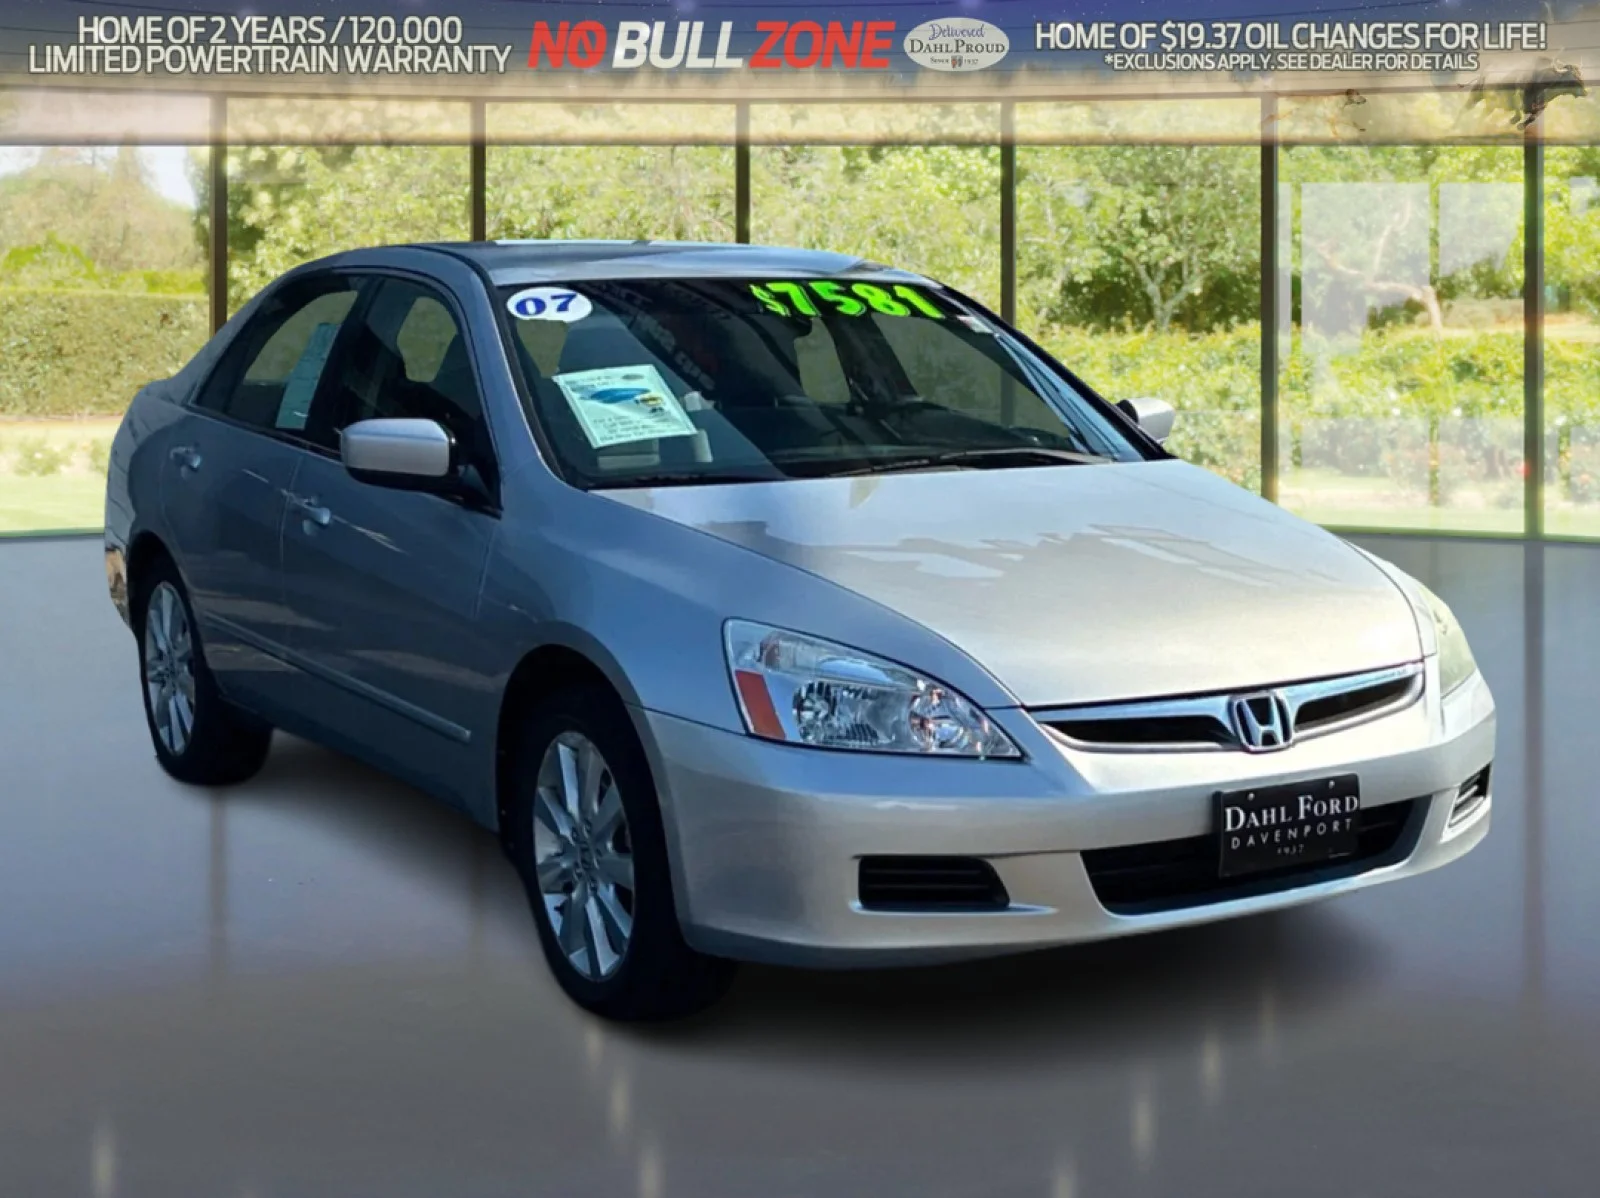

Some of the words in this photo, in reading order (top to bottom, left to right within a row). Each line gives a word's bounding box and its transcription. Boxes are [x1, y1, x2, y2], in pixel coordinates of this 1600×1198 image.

[515, 292, 577, 316] 07
[750, 281, 946, 319] $7581
[1224, 805, 1292, 832] DAHL
[1297, 795, 1358, 820] FORD
[1230, 818, 1352, 850] DAVENPORT
